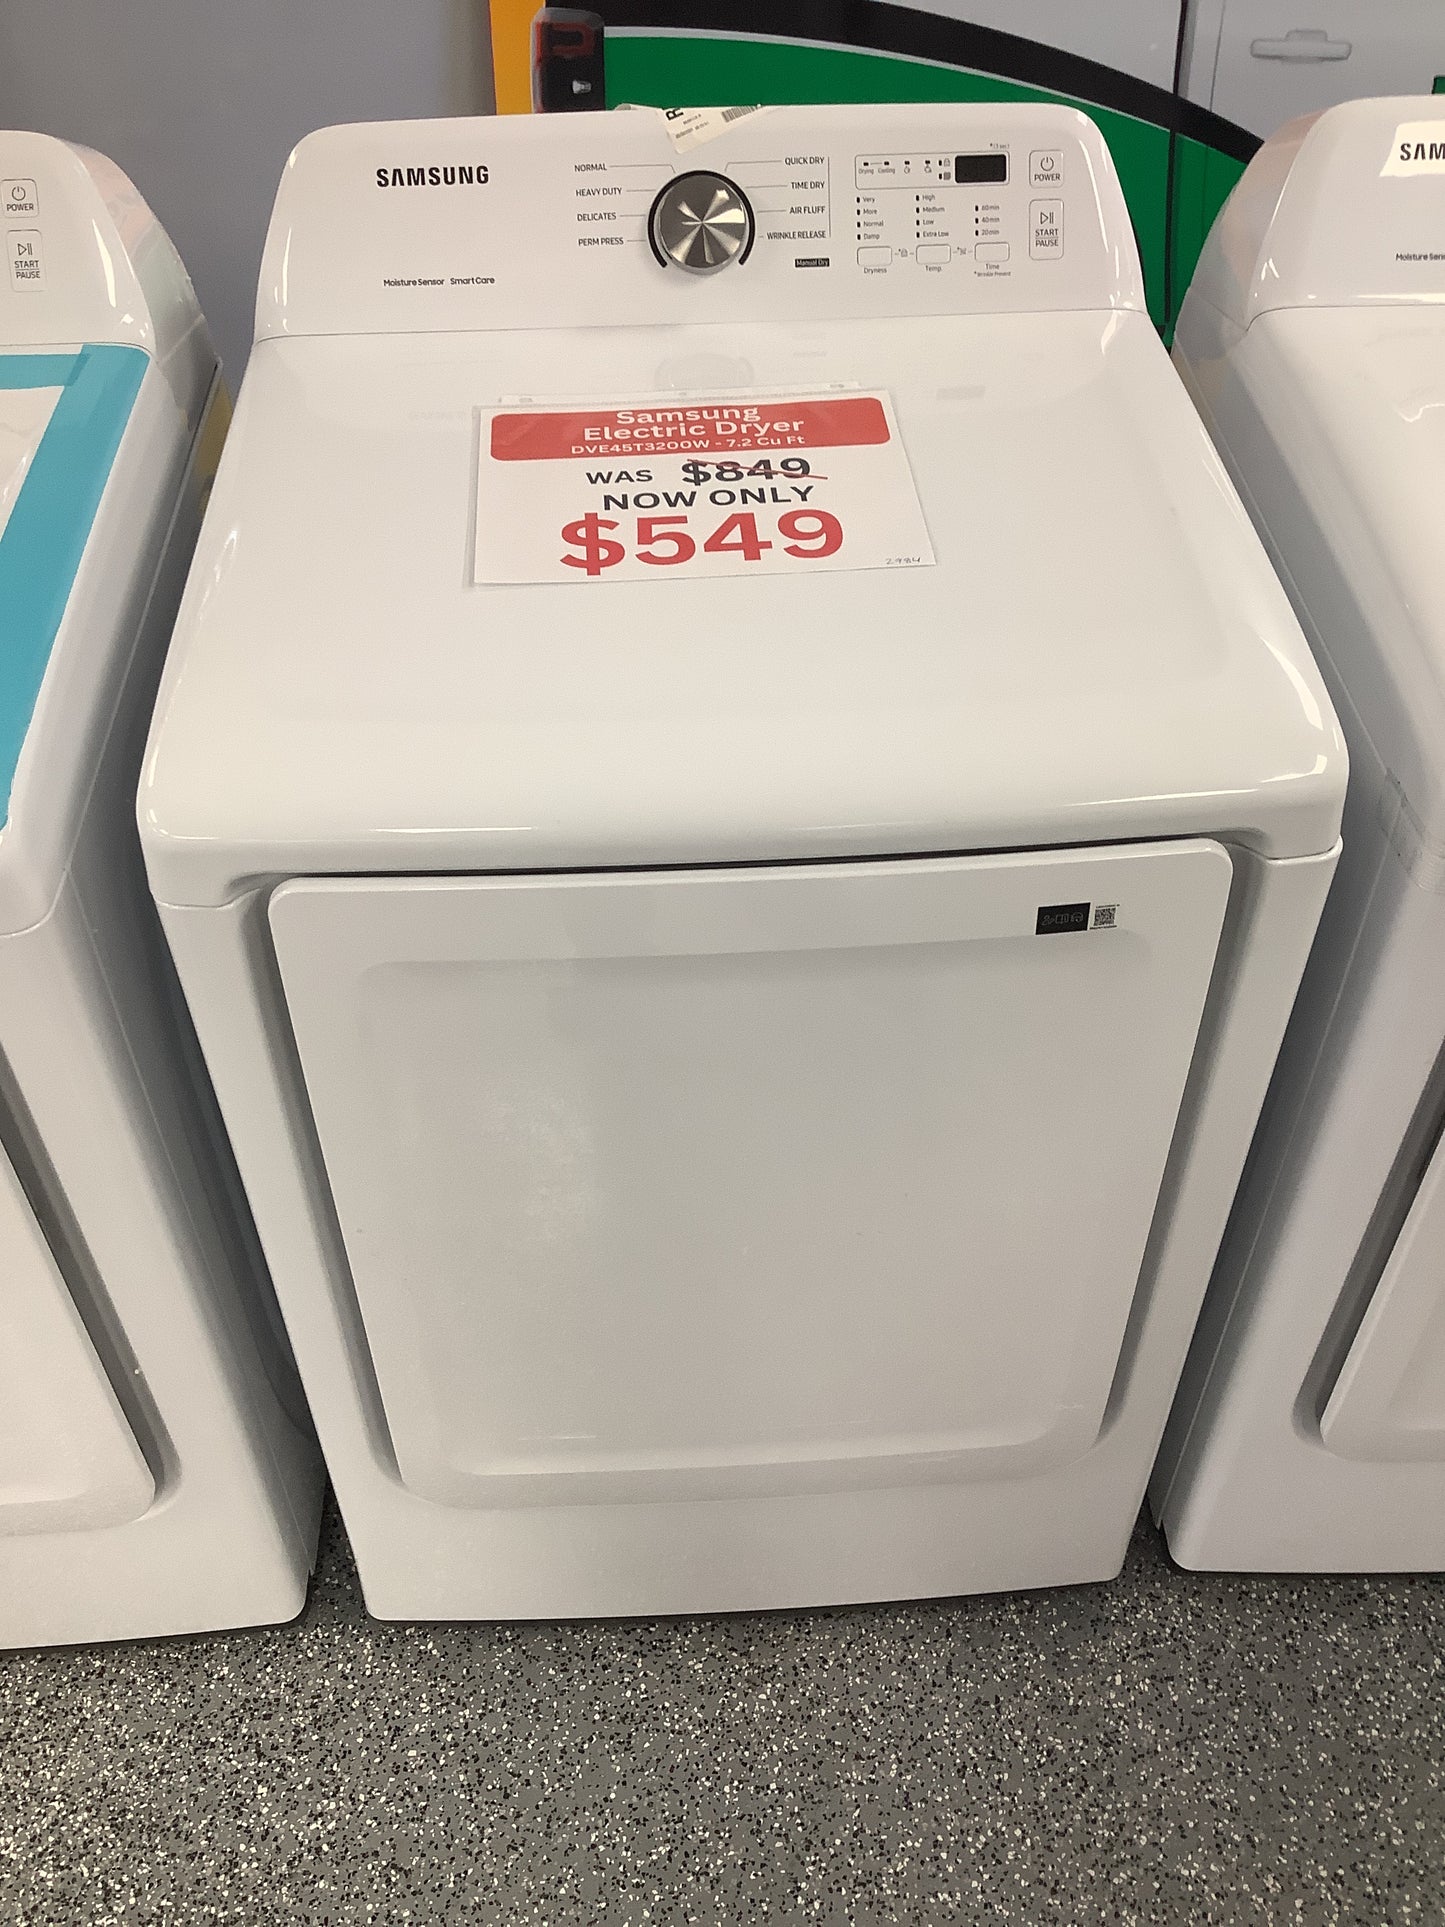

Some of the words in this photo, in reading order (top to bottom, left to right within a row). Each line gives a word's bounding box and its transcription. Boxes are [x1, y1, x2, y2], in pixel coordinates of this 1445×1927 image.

[785, 157, 808, 166] QUICK
[809, 157, 825, 165] DRY
[574, 163, 607, 172] NORMAL
[858, 168, 874, 176] Drying
[376, 165, 489, 188] SAMSUNG
[810, 181, 825, 189] DRY
[575, 188, 600, 197] HEAVY
[602, 187, 622, 196] DUTY
[922, 194, 936, 202] High
[6, 203, 34, 212] POWER
[789, 206, 802, 214] AIR
[803, 205, 826, 214] FLUFF
[577, 212, 617, 222] DELICATES
[922, 218, 935, 226] Low
[766, 231, 796, 240] WRINKLE
[797, 230, 827, 239] RELEASE
[863, 233, 880, 241] Damp
[1035, 228, 1059, 237] START
[578, 238, 600, 247] PERM
[601, 237, 625, 246] PRESS
[1035, 239, 1059, 248] PAUSE
[1395, 252, 1428, 261] Moisture
[14, 260, 40, 269] START
[796, 259, 817, 268] Manual
[817, 258, 829, 268] Dry
[16, 271, 41, 279] PAUSE
[863, 267, 888, 275] Dryness
[383, 279, 417, 287] Moisture
[418, 278, 445, 286] Sensor
[450, 277, 475, 285] Smart
[475, 276, 495, 285] Care
[616, 407, 761, 424] Samsung
[583, 423, 706, 441] Electric
[715, 419, 804, 437] Dryer
[571, 438, 709, 454] DVE45T3200W
[726, 438, 752, 448] 7.2
[757, 436, 782, 446] Cu
[787, 435, 805, 445] Ft
[586, 469, 653, 484] WAS
[681, 458, 811, 486] $849
[603, 490, 697, 511] NOW
[709, 485, 814, 506] ONLY
[560, 509, 843, 575] $549
